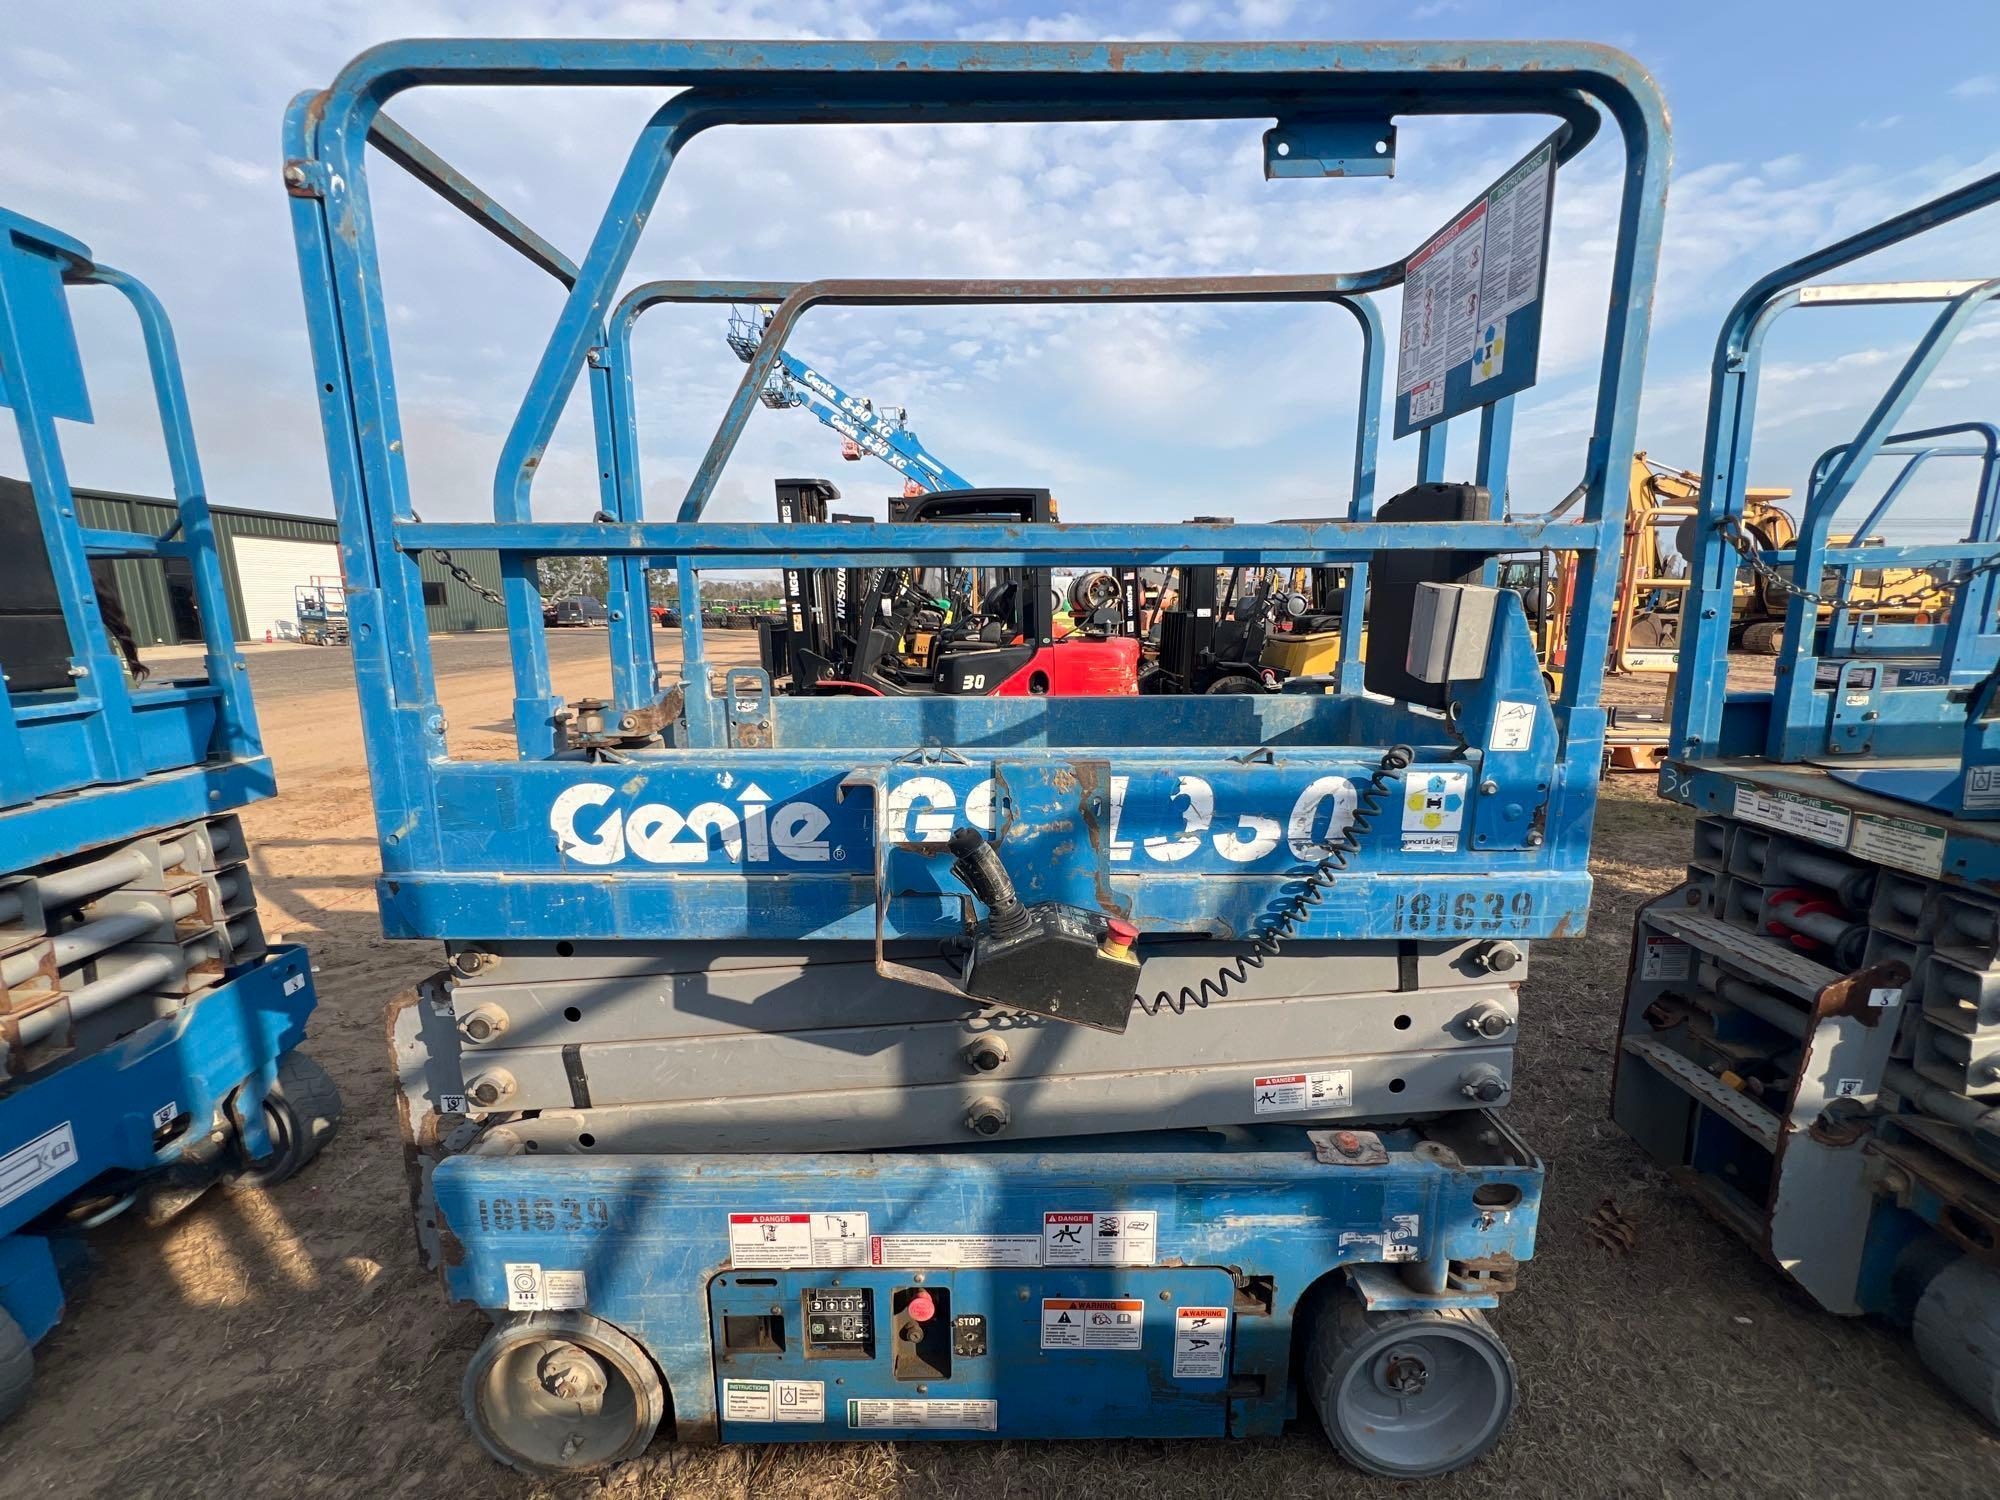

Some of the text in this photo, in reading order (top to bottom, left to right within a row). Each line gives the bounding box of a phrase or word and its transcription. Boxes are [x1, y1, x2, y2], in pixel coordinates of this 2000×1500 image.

[1435, 224, 1460, 250] DANGER
[804, 370, 893, 438] Genie S-80 XC
[831, 414, 908, 469] Genie S-80 XC
[961, 674, 985, 691] 30
[550, 782, 831, 865] Genie
[1393, 891, 1533, 932] 181639
[1271, 1076, 1296, 1086] DANGER
[478, 1197, 609, 1232] 181639
[759, 1215, 791, 1224] DANGER
[1057, 1214, 1090, 1223] DANGER
[872, 1237, 880, 1260] DANGER
[1078, 1302, 1117, 1311] WARNING
[958, 1317, 981, 1326] STOP
[728, 1384, 769, 1392] INSTRUCTIONS
